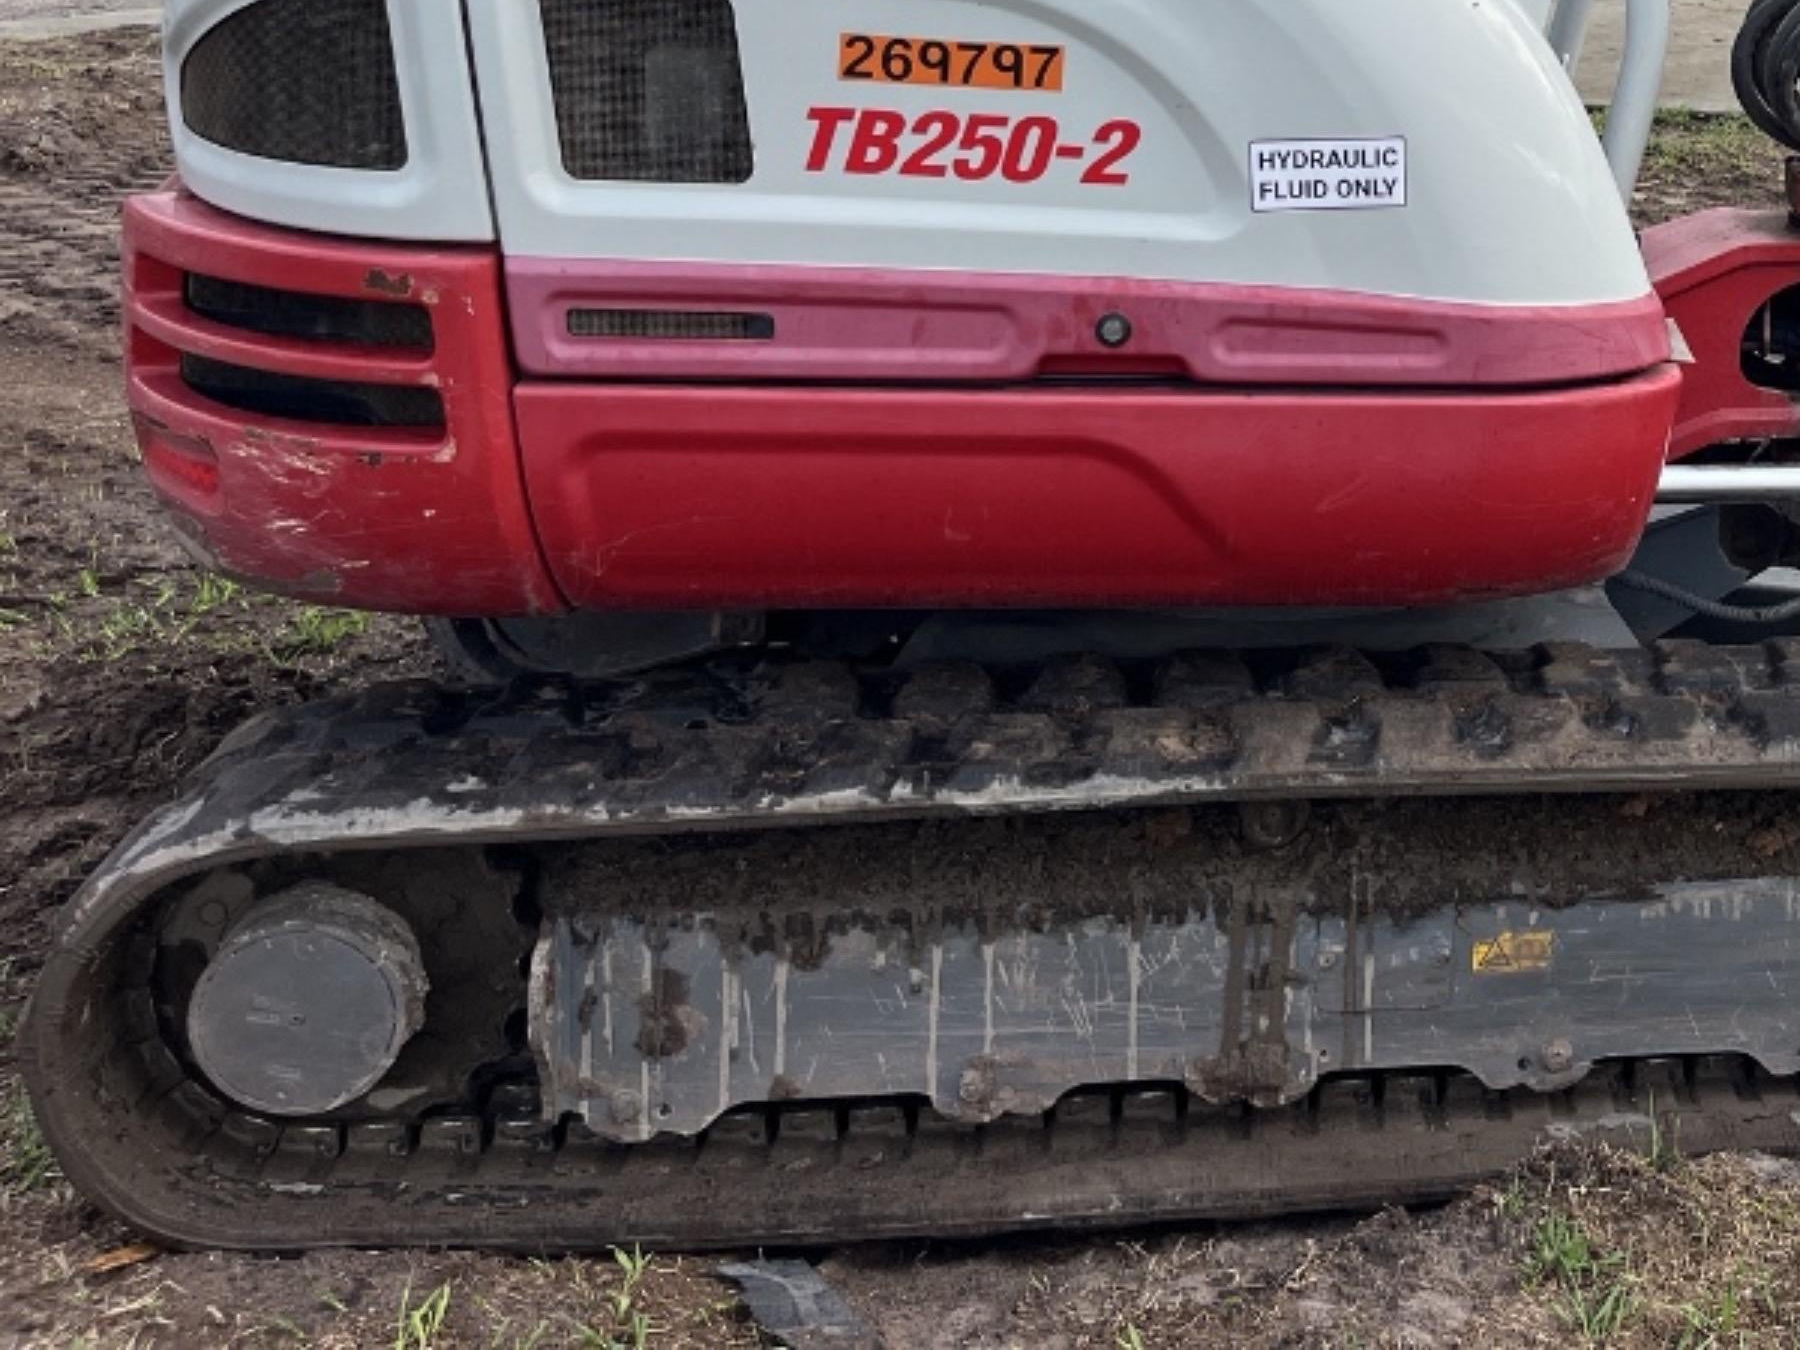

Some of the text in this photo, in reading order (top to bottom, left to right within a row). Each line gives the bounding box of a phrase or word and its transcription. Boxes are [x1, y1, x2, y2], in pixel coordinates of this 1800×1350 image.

[842, 35, 1060, 88] 269797
[804, 106, 1142, 186] TB250-2
[1258, 147, 1399, 171] HYDRAULIC
[1259, 177, 1398, 201] FLUID ONLY
